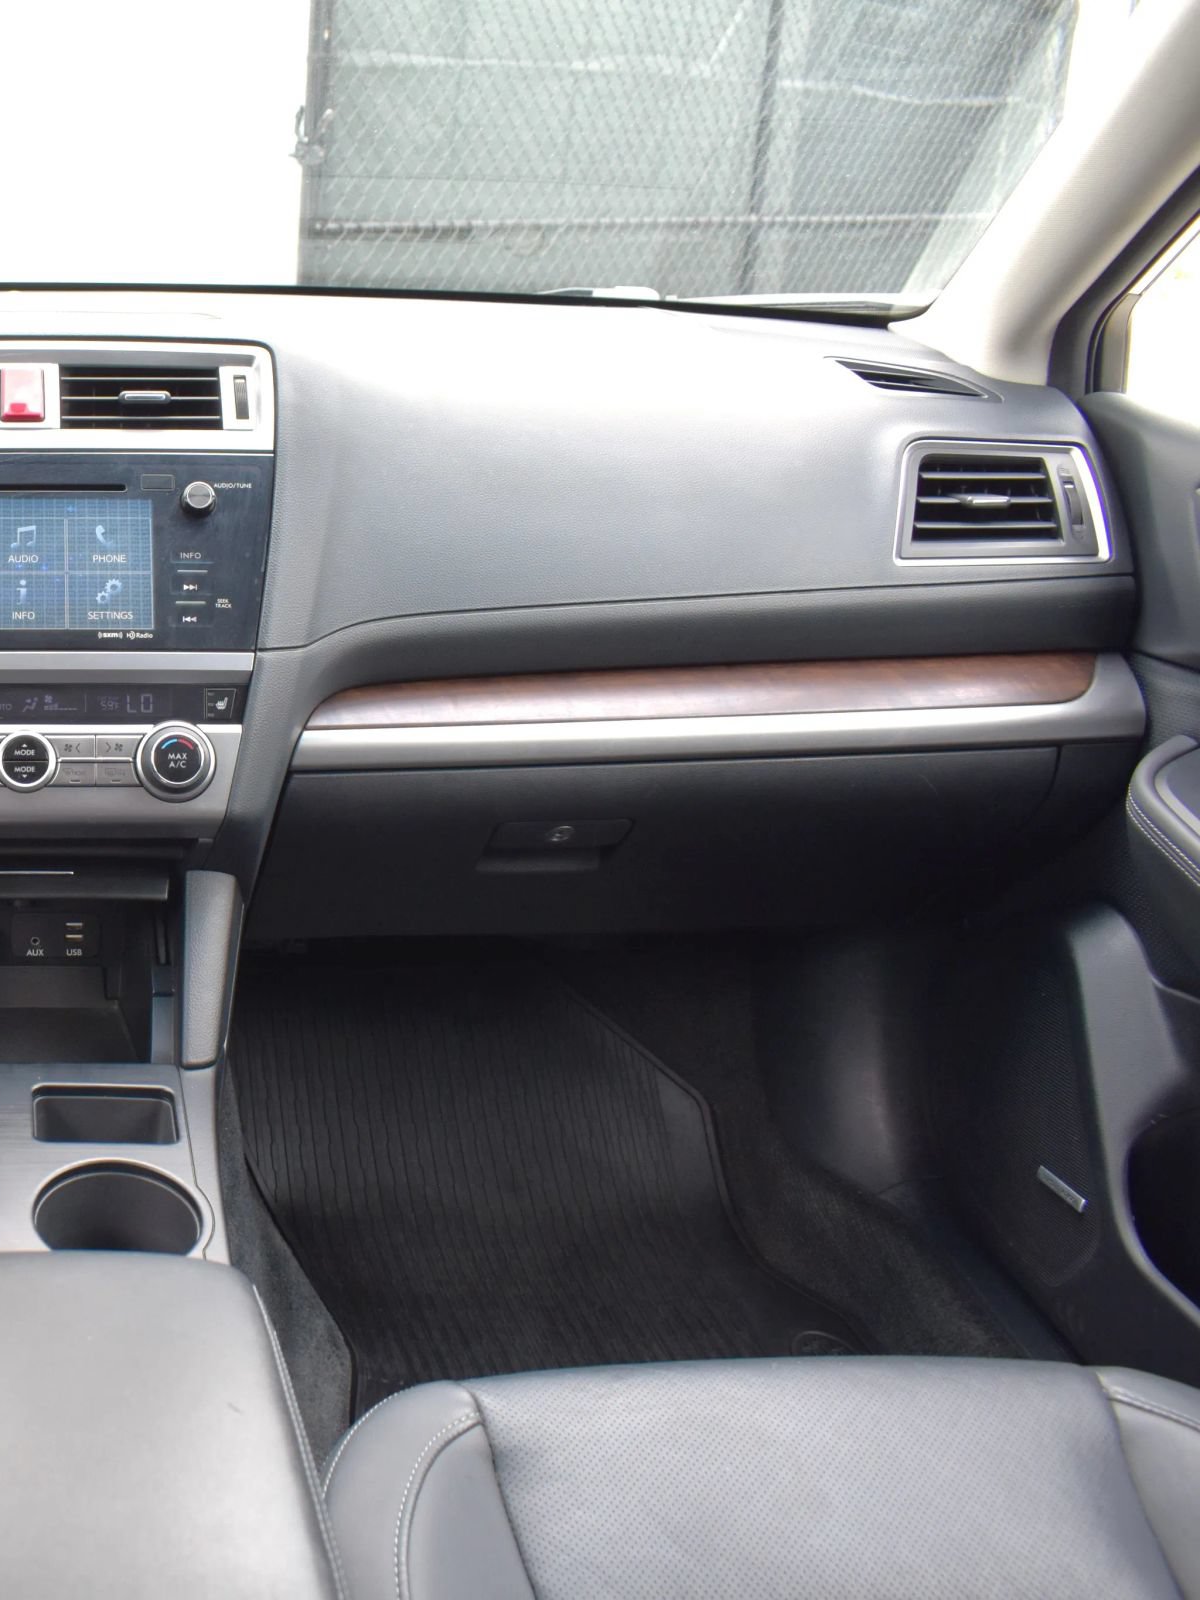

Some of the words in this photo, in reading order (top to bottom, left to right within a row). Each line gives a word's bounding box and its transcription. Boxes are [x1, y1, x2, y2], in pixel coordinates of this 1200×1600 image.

[8, 554, 39, 564] AUDIO
[92, 554, 127, 564] PHONE
[180, 552, 202, 560] INFO
[12, 611, 36, 620] INFO
[87, 611, 134, 620] SETTINGS
[168, 752, 188, 760] MAX
[169, 761, 187, 769] A/C
